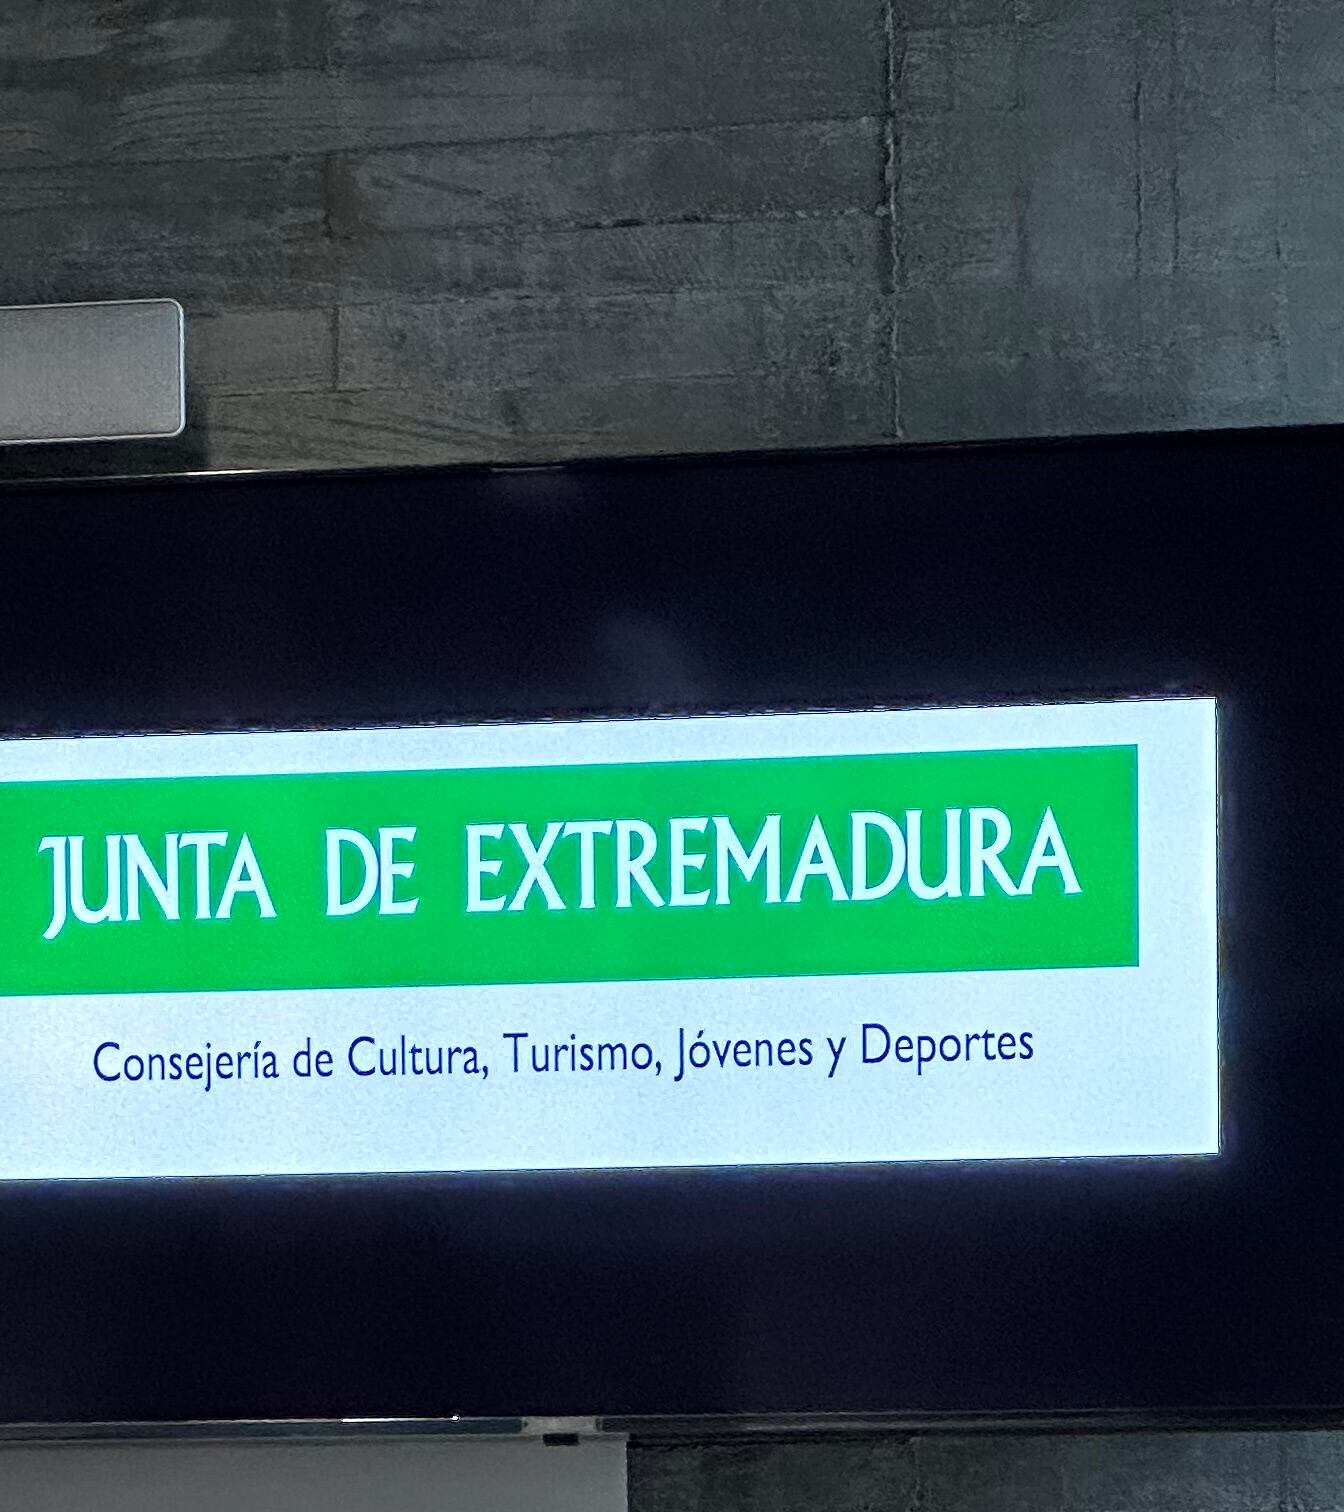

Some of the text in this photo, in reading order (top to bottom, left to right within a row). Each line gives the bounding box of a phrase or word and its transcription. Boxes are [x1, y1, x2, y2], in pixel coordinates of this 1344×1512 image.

[37, 804, 1083, 941] JUNTA DE EXTREMADURA
[93, 1022, 1035, 1093] Consejería de Cultura, Turismo, Jóvenes y Deportes
